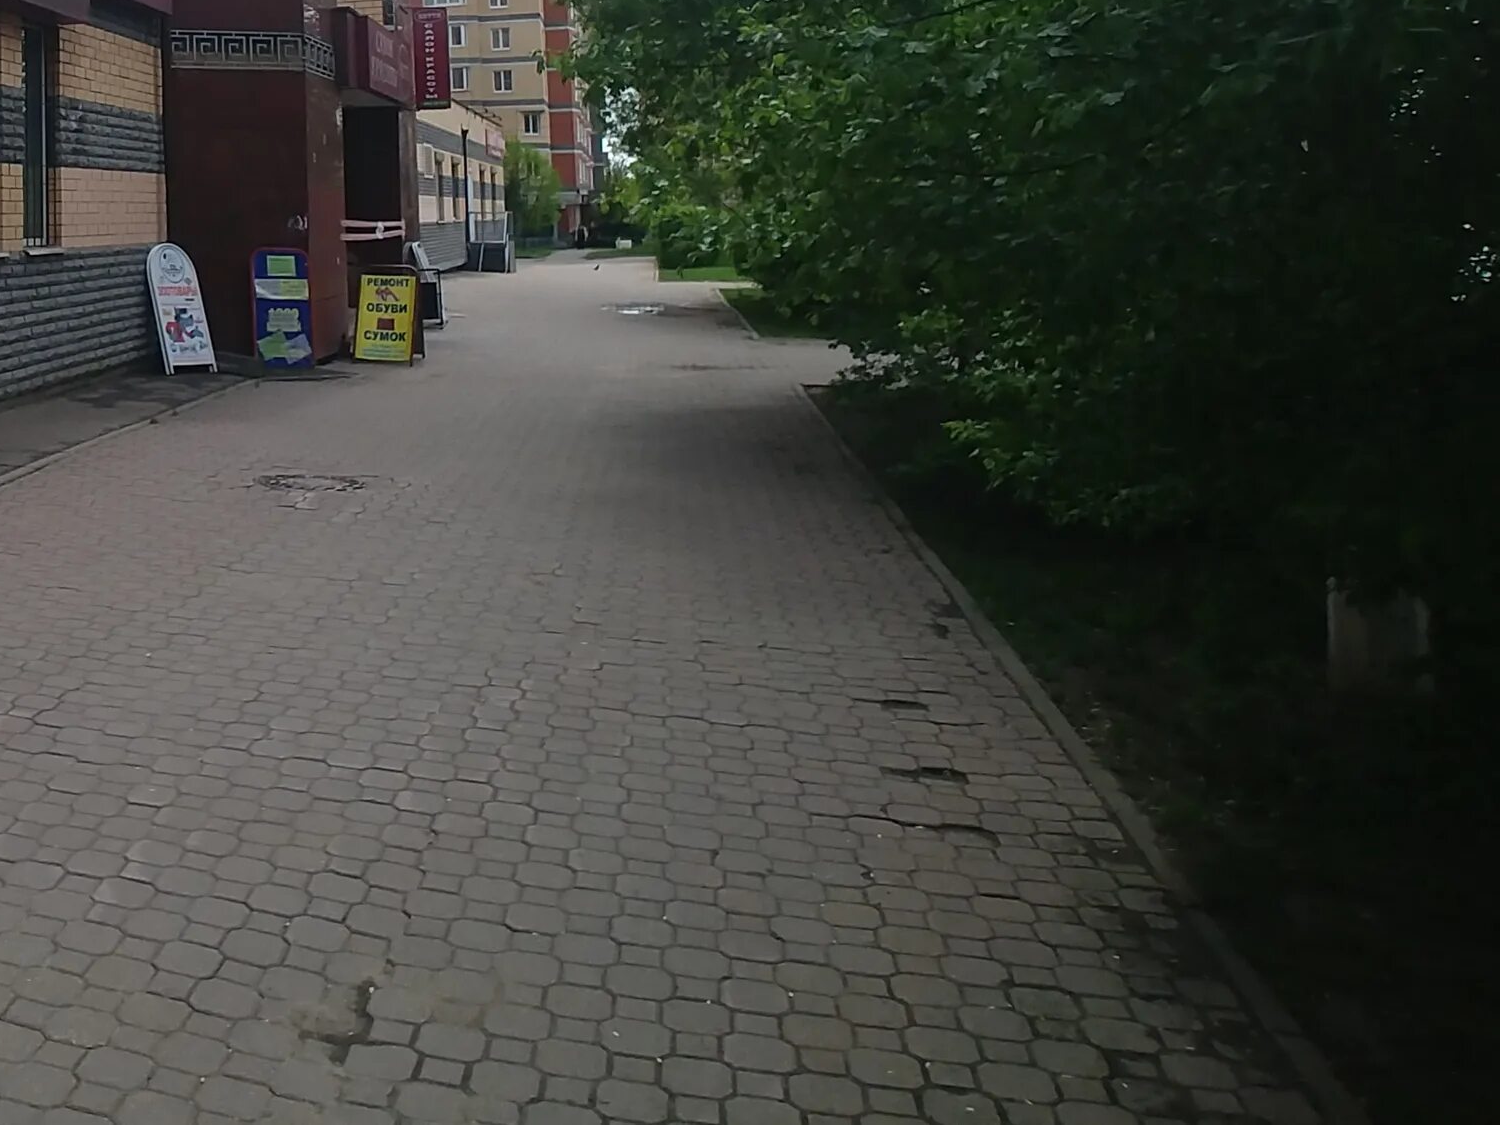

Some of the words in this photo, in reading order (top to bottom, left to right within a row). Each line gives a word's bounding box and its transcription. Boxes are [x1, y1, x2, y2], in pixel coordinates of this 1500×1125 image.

[367, 277, 410, 287] РЕМОНТ
[366, 302, 407, 313] ОБУВИ
[364, 330, 406, 342] СУМОК
